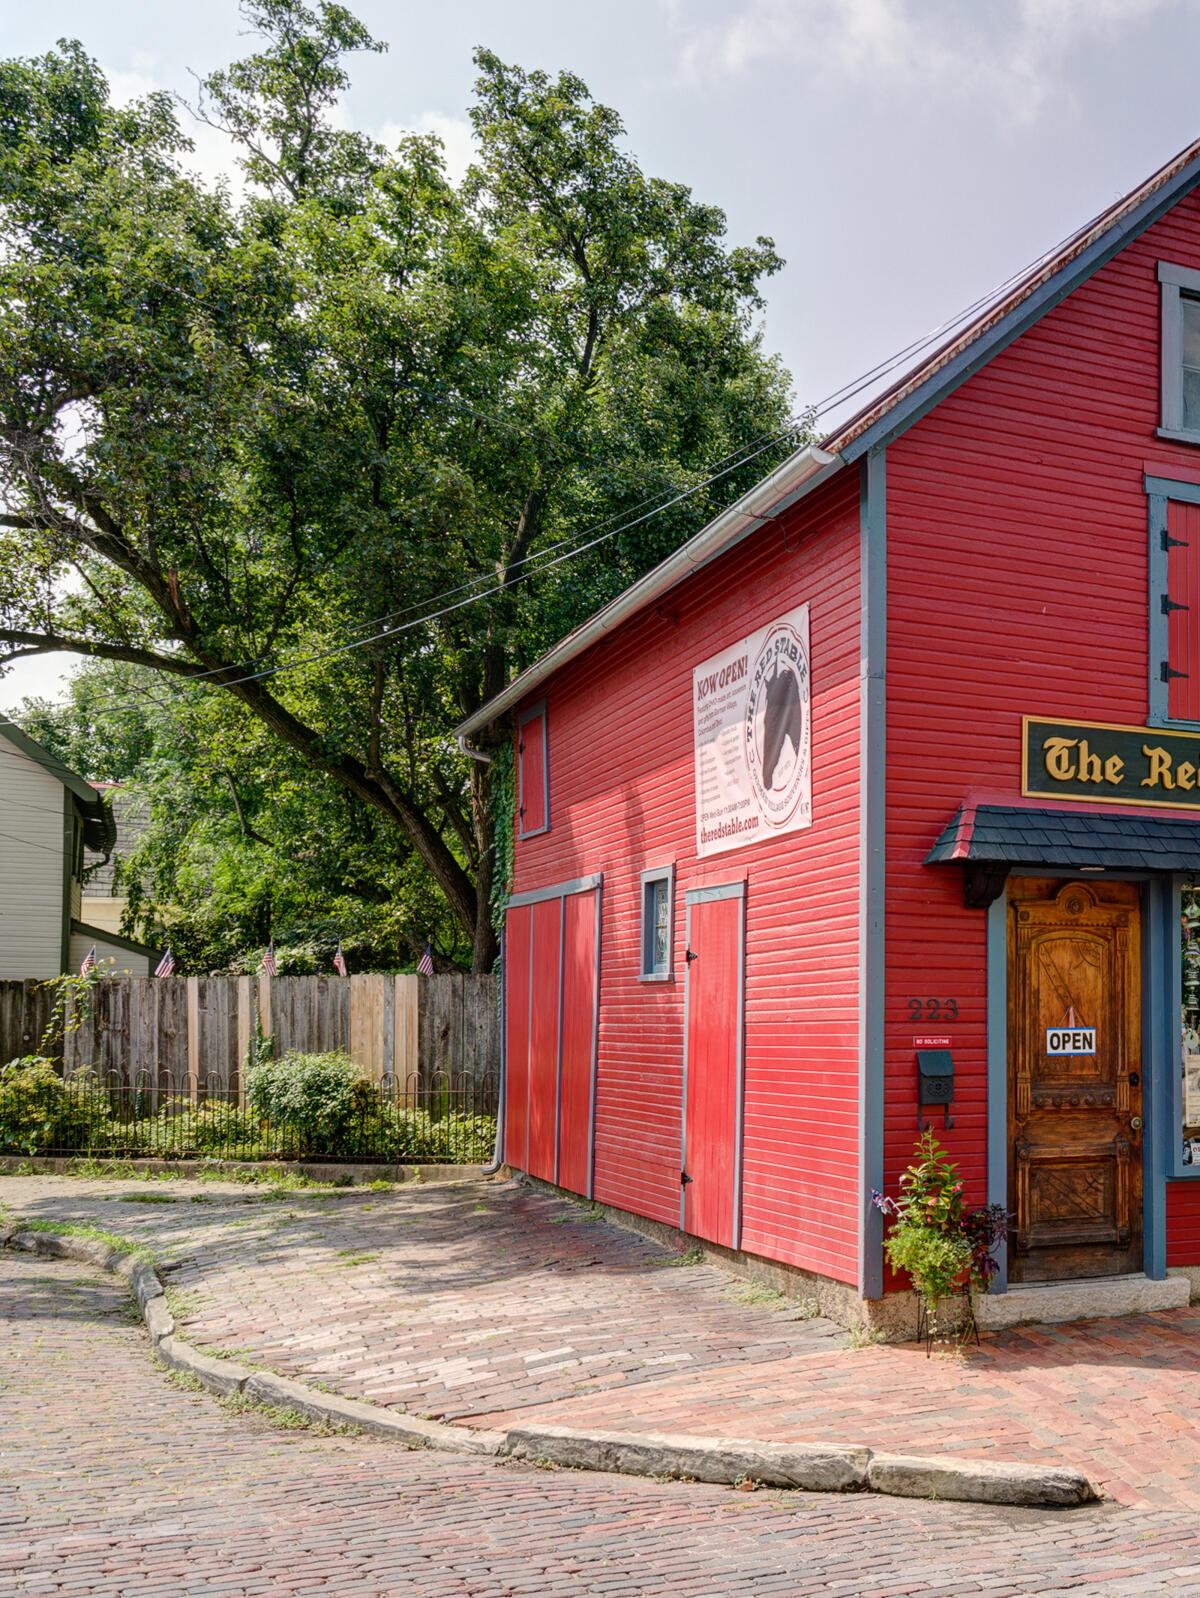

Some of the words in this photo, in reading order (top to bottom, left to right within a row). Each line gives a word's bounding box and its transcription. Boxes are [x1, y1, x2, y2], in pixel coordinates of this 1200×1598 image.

[697, 671, 719, 701] NOW
[718, 655, 748, 689] OPEN!
[747, 689, 757, 742] THE
[755, 647, 773, 688] RED
[775, 637, 808, 683] STABLE
[1043, 736, 1126, 784] The
[701, 816, 759, 844] theredstable.com
[908, 998, 959, 1020] 223
[1050, 1032, 1093, 1050] OPEN
